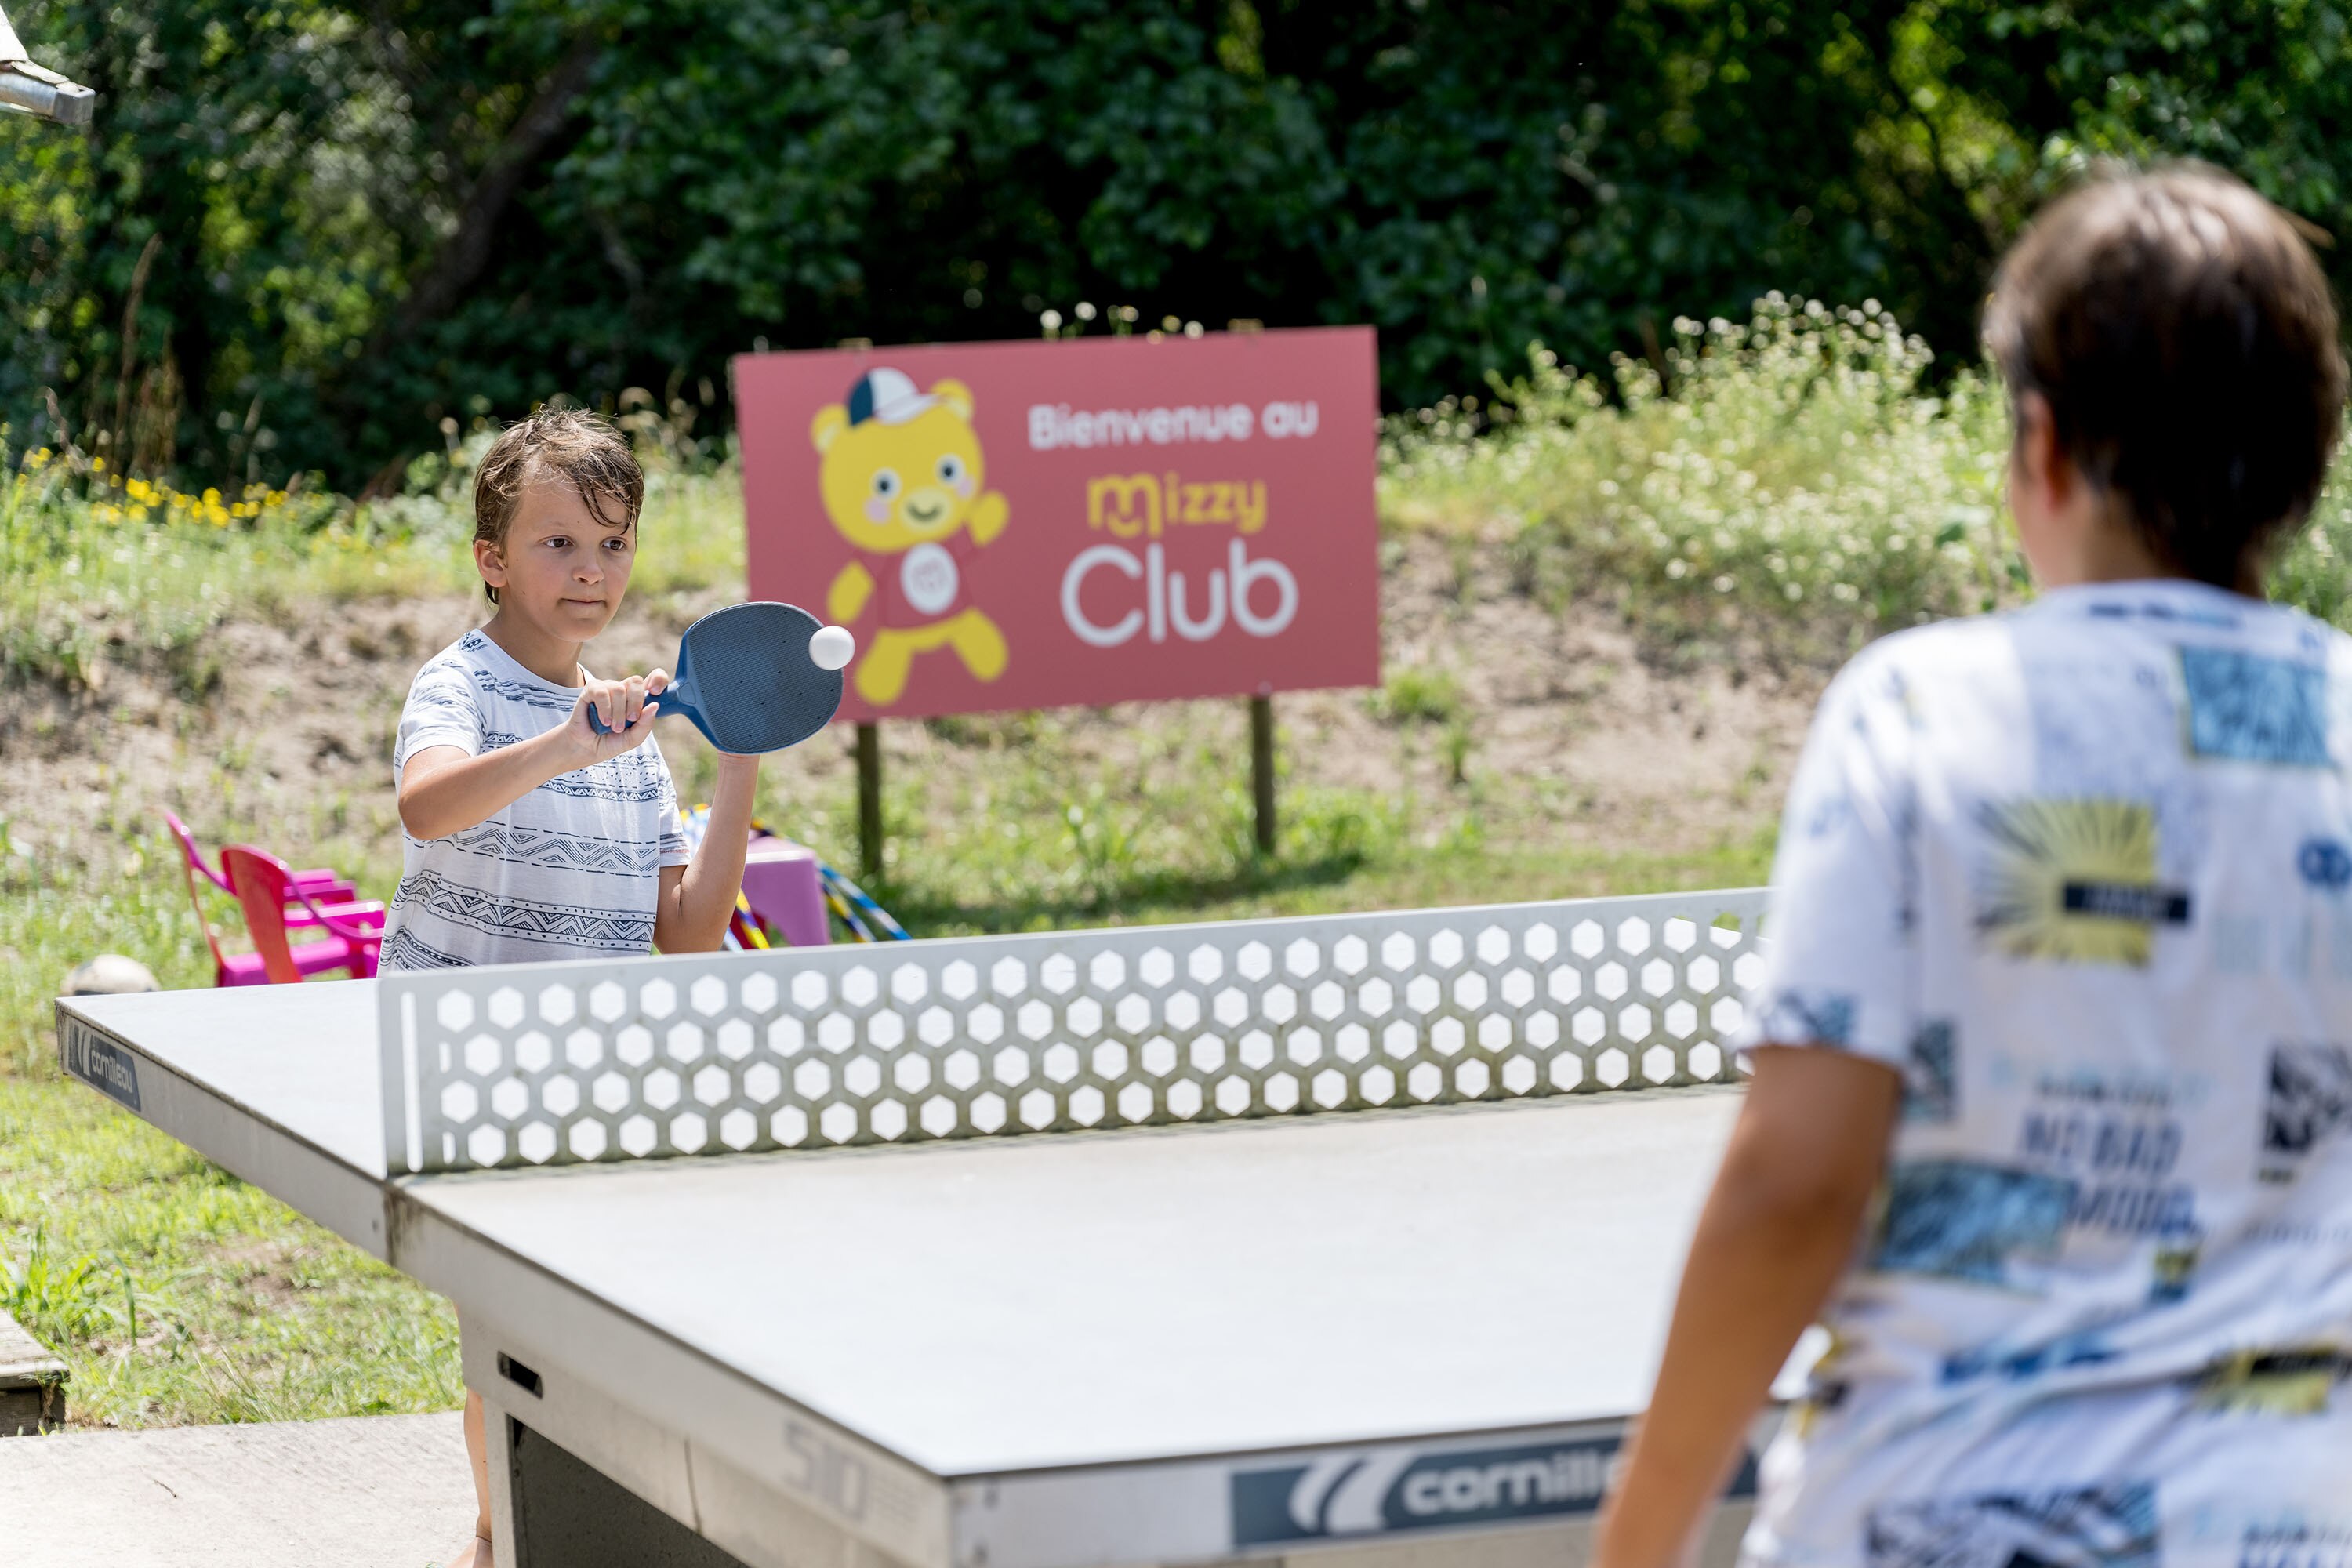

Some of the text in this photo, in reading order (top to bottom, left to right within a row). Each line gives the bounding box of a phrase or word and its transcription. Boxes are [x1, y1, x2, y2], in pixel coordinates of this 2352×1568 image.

[1028, 400, 1319, 450] Bienvenue au
[1061, 537, 1299, 648] Club
[91, 1049, 132, 1094] cornilleau
